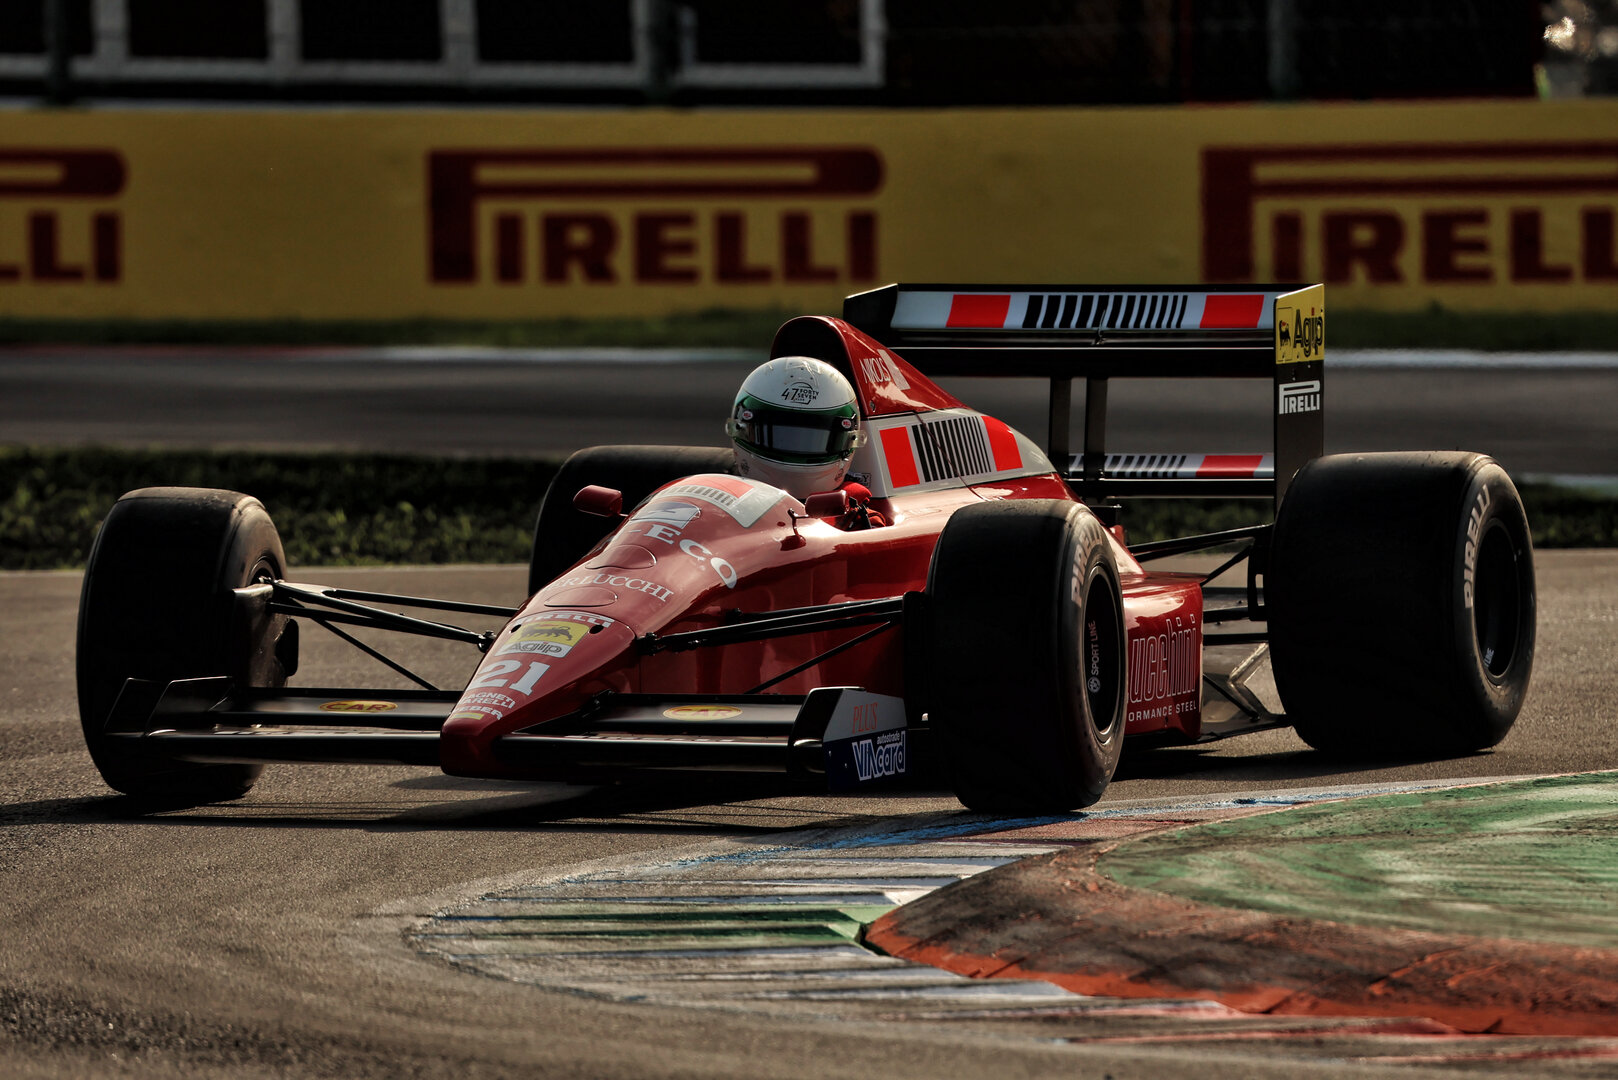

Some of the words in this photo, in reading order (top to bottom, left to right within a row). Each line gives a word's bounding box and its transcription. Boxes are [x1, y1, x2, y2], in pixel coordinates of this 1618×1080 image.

[430, 150, 886, 285] PIRELLI
[1202, 145, 1618, 284] PIRELL
[1293, 307, 1323, 358] Agip
[781, 388, 799, 401] 47
[1279, 380, 1321, 415] PIRELLI
[640, 524, 737, 589] ECO
[1464, 483, 1491, 609] PIRELLI
[551, 573, 675, 603] ERLUCCHI
[1088, 620, 1098, 642] LINE
[1091, 643, 1100, 676] SPORT
[1128, 613, 1198, 703] ucchini
[467, 659, 550, 696] 21
[326, 703, 388, 711] CAR
[457, 705, 503, 720] EBER
[671, 708, 733, 718] CAR
[852, 702, 878, 734] PLUS
[1128, 705, 1173, 722] ORMANCE
[1175, 700, 1197, 714] STEEL
[852, 731, 906, 781] VIAcard
